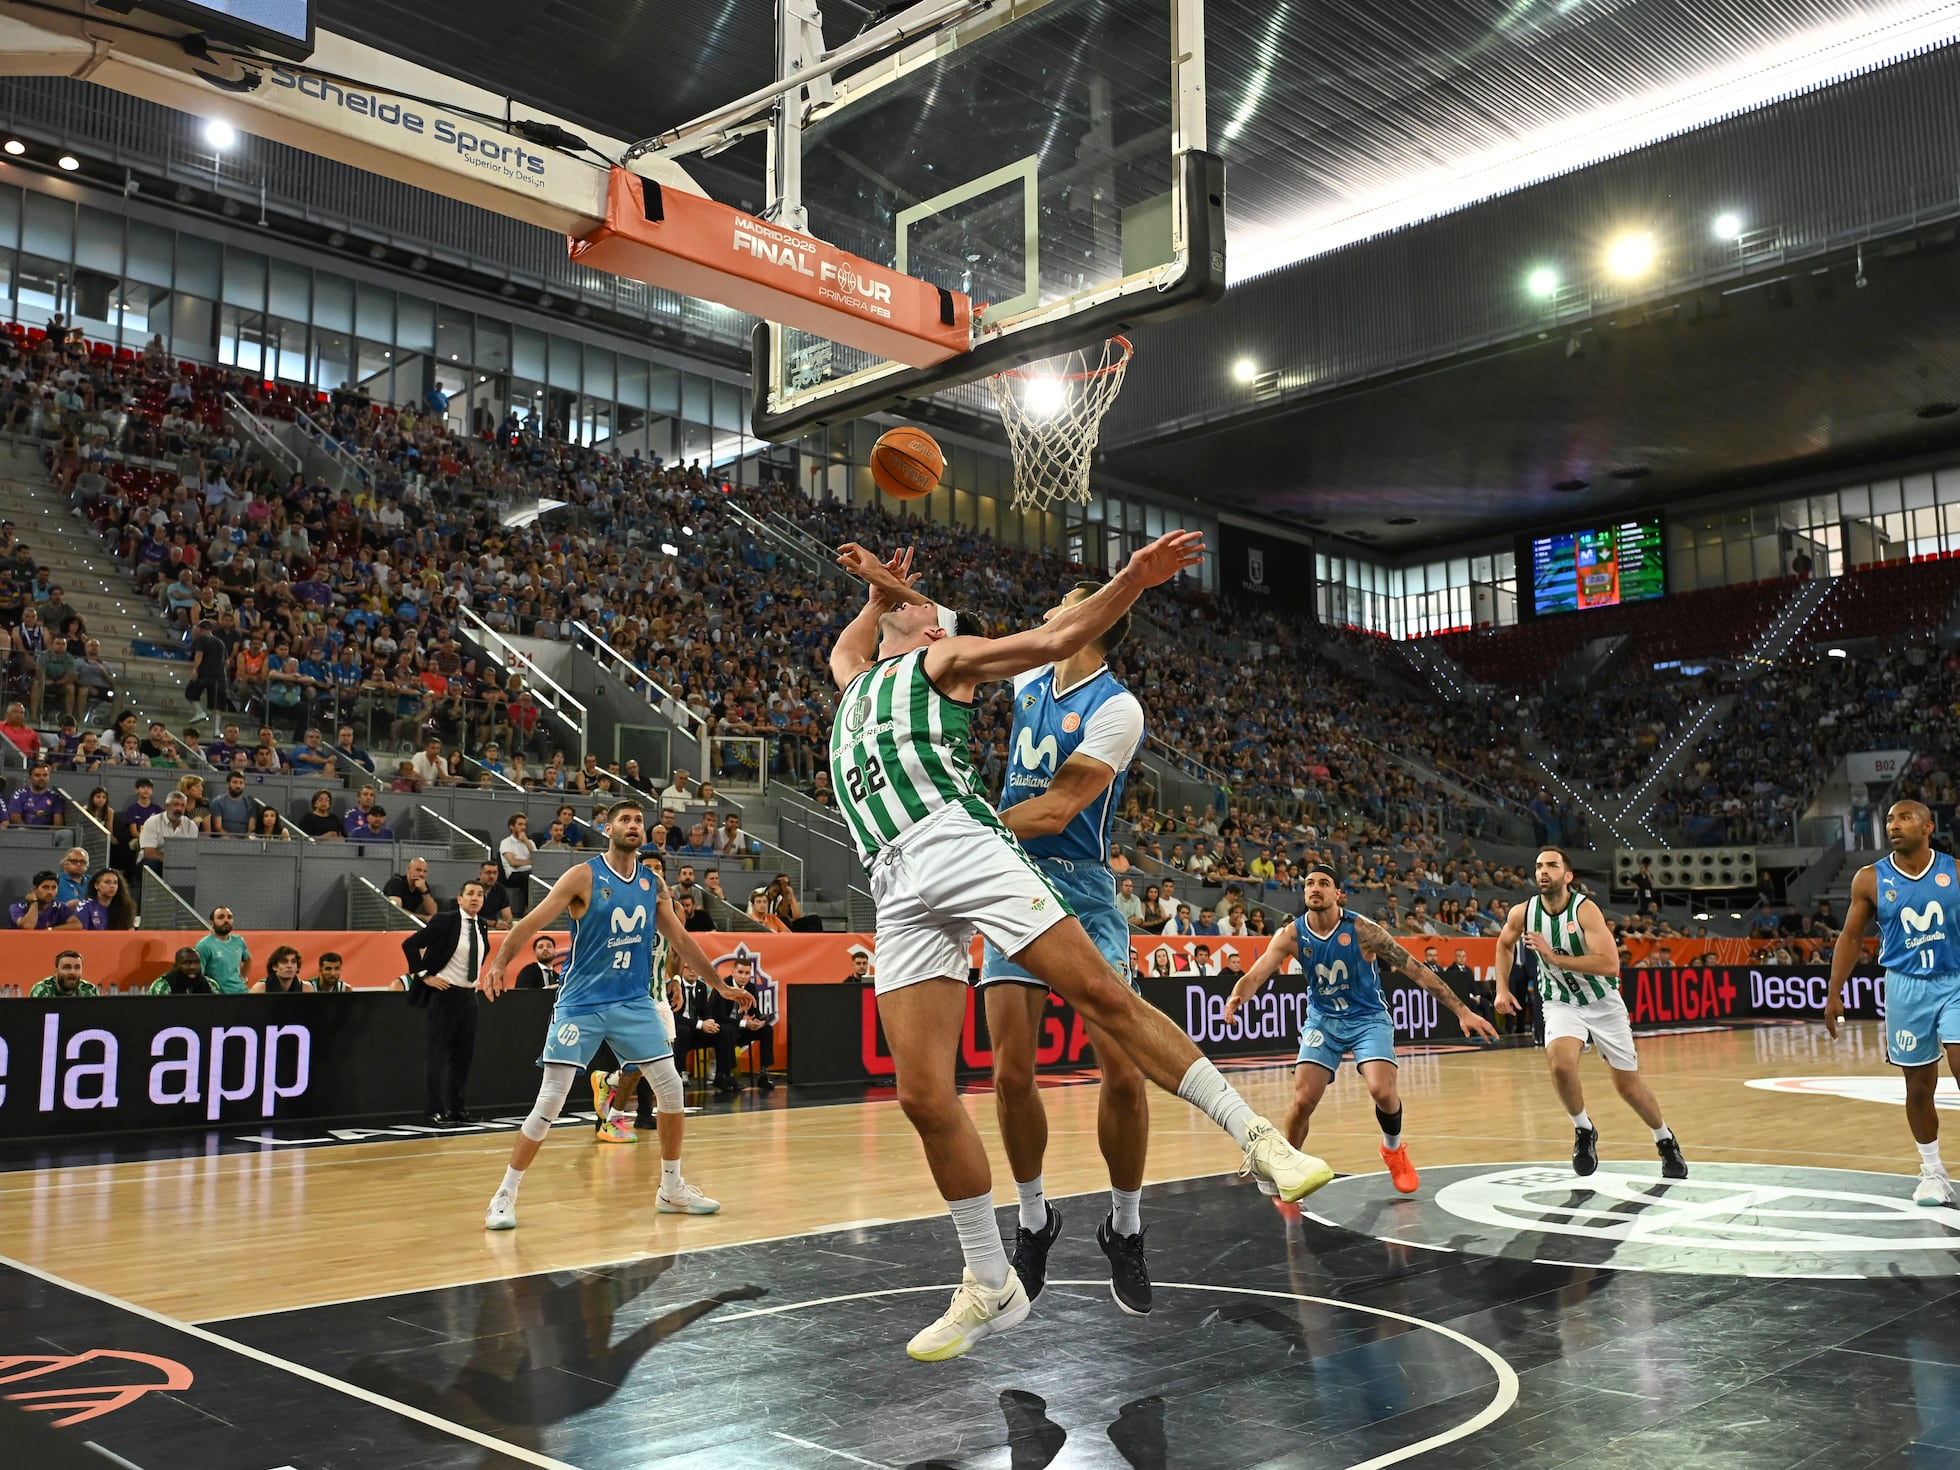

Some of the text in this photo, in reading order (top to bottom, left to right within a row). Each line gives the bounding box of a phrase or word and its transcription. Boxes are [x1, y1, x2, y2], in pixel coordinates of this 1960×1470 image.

[271, 64, 545, 175] Schelde Sports
[464, 153, 545, 188] Superior by Design
[735, 216, 816, 253] MADRID2025
[733, 230, 814, 277] FINAL
[819, 287, 891, 319] PRIMERA FEB
[855, 722, 894, 743] HEREDA
[846, 755, 886, 804] 22
[1875, 760, 1895, 772] B02
[612, 950, 631, 969] 29
[1920, 949, 1934, 969] 11
[1619, 967, 1737, 1024] ALIGA+
[1392, 988, 1438, 1039] app
[558, 1023, 579, 1046] hp
[1305, 1029, 1324, 1047] hp
[1896, 1030, 1917, 1051] hp
[39, 1012, 119, 1112] la
[149, 1024, 311, 1121] app
